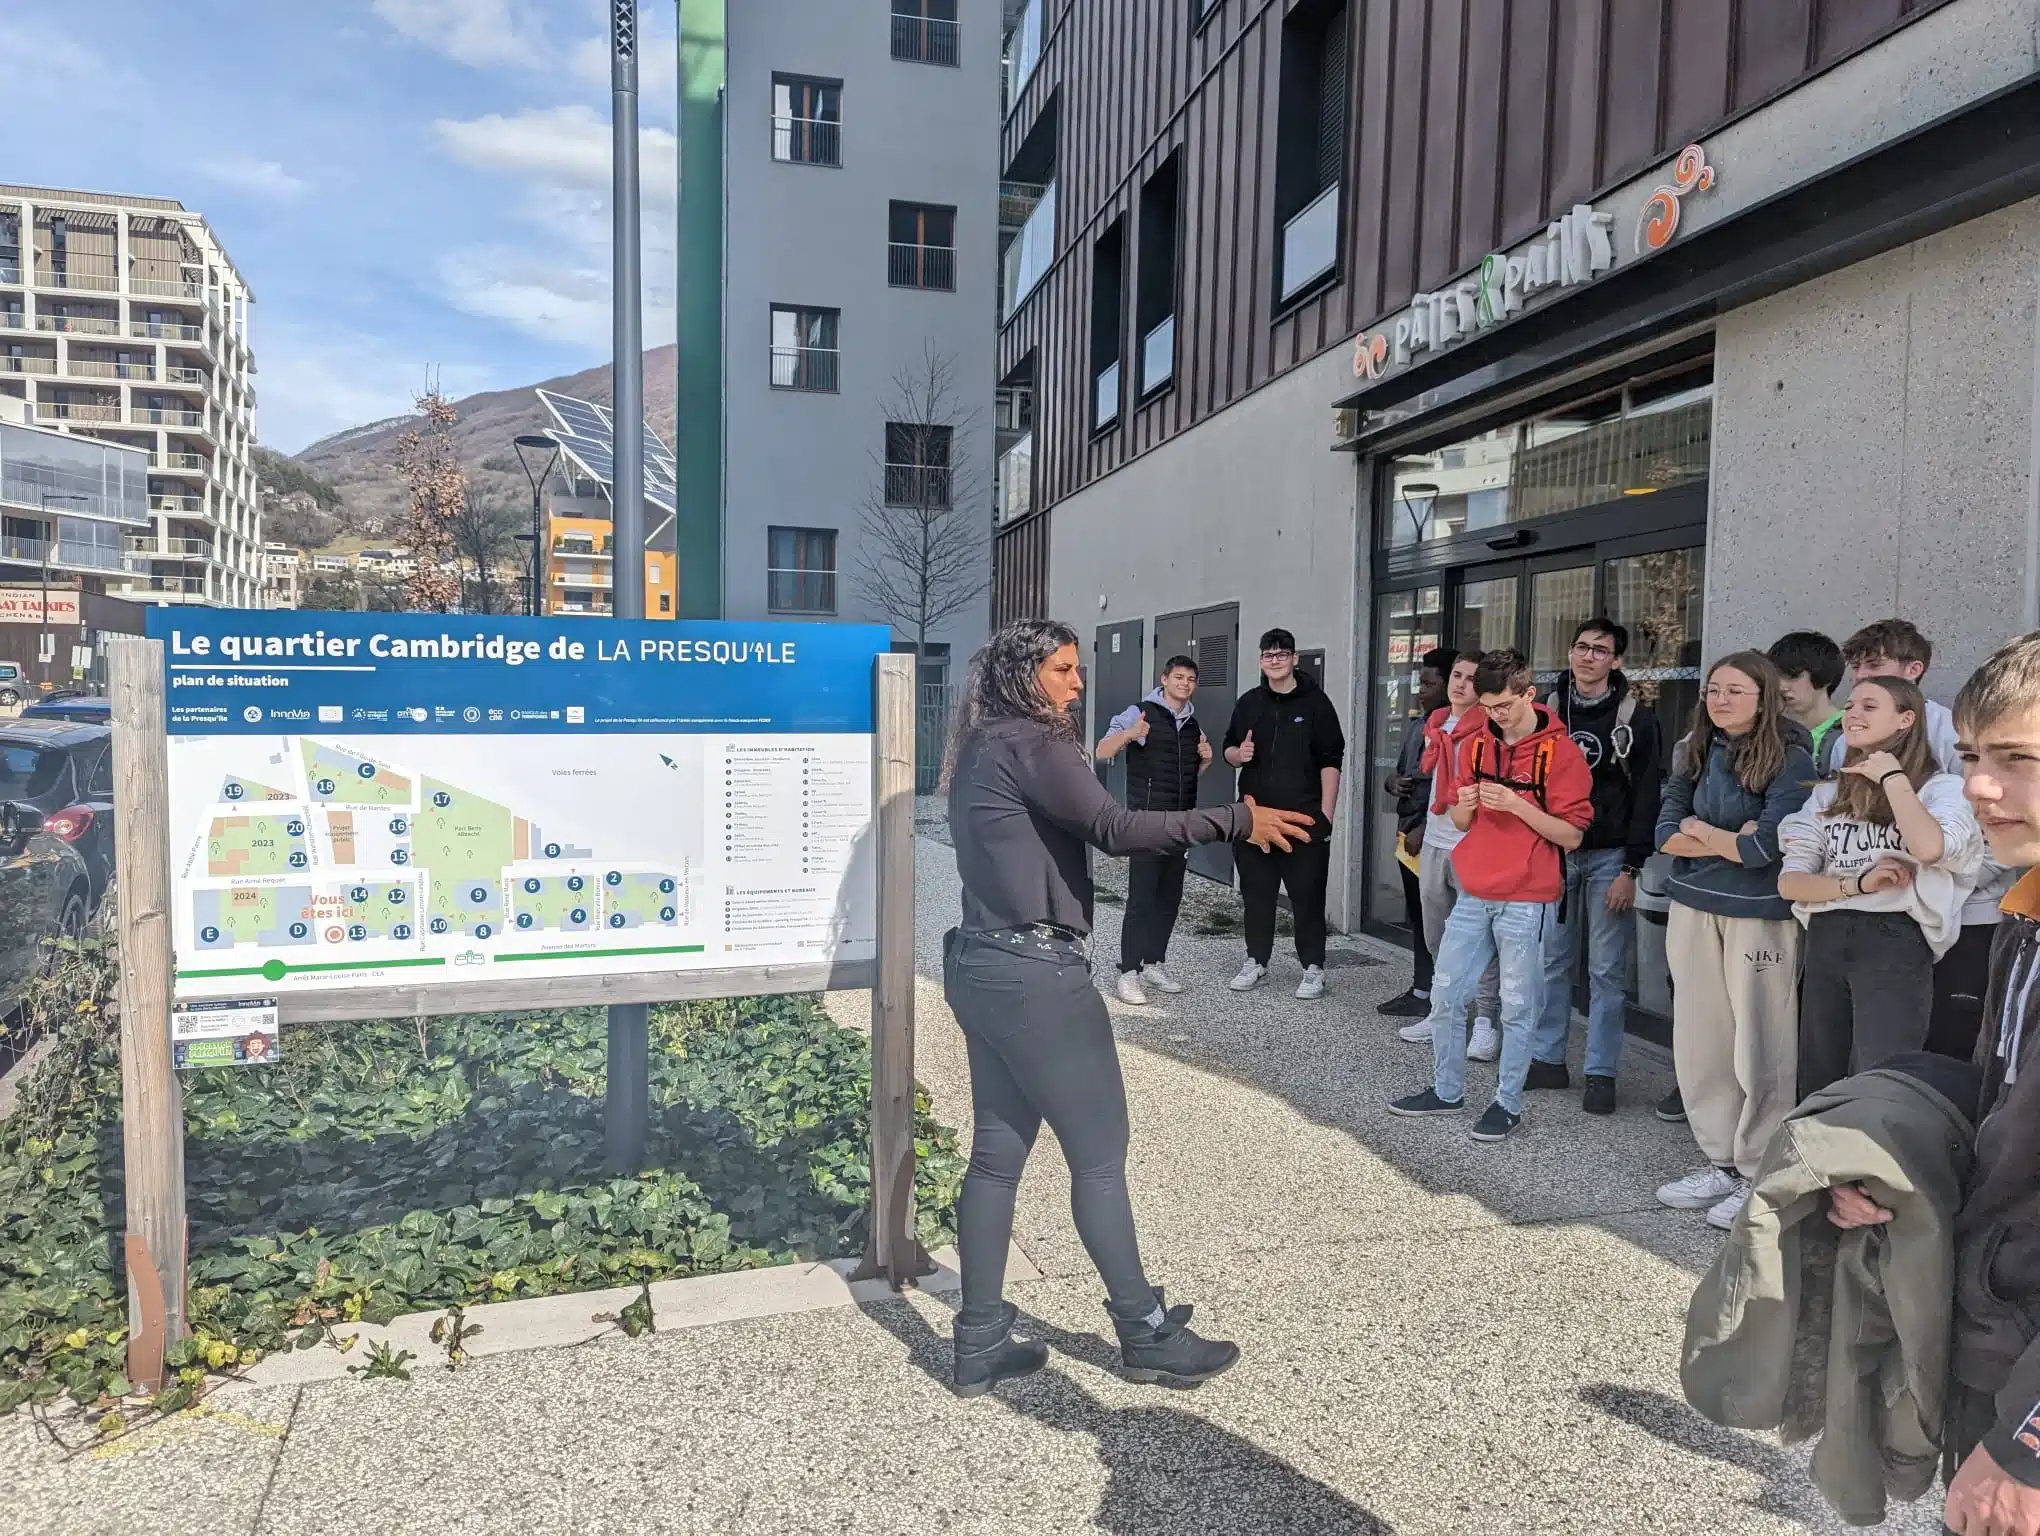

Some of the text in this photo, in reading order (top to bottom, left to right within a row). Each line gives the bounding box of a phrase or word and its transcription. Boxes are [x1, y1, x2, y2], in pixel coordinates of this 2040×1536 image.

[172, 630, 210, 656] Le
[219, 631, 361, 661] quartier
[369, 633, 541, 665] Cambridge
[549, 636, 585, 660] de
[598, 639, 631, 661] LA
[173, 674, 289, 688] plan de situation
[185, 706, 228, 715] partenaires
[227, 786, 242, 796] 19
[319, 781, 334, 791] 18
[435, 794, 448, 804] 17
[288, 823, 303, 833] 20
[391, 822, 404, 831] 16
[251, 839, 274, 847] 2023
[291, 855, 305, 864] 21
[392, 851, 406, 862] 15
[233, 892, 256, 900] 2024
[352, 889, 366, 899] 14
[390, 891, 403, 901] 12
[308, 894, 345, 905] Vous
[301, 905, 354, 919] êtes ici
[432, 921, 445, 930] 10
[350, 927, 365, 938] 13
[395, 927, 409, 937] 11
